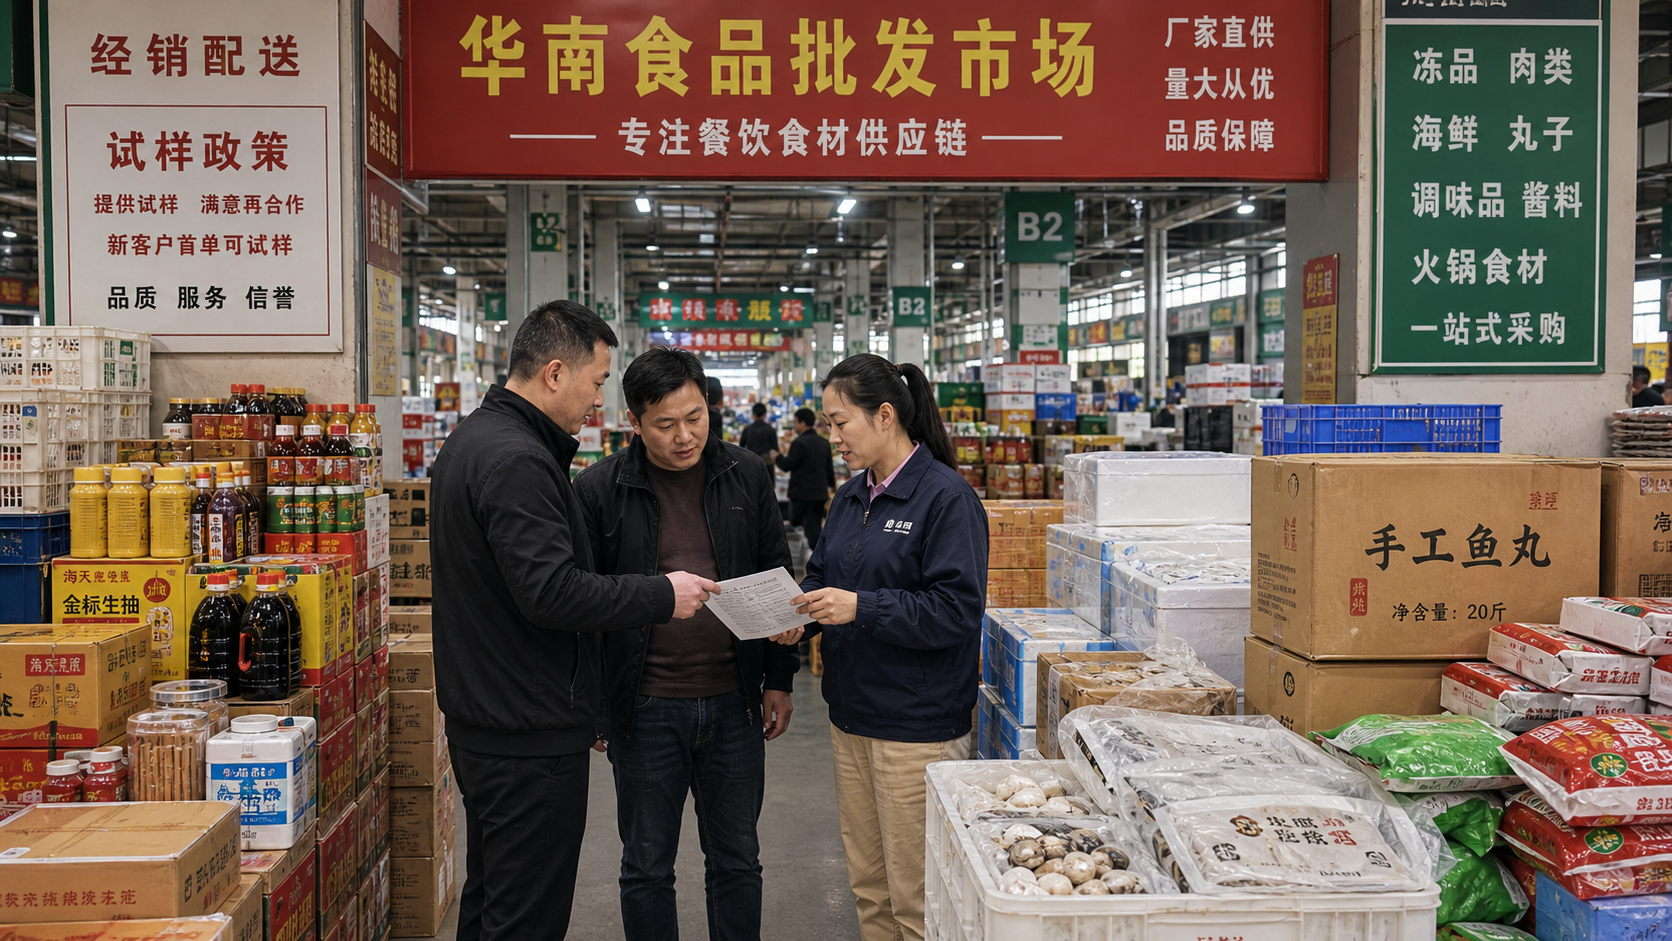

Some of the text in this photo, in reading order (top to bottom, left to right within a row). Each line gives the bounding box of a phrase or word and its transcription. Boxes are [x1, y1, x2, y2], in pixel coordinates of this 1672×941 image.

[1165, 15, 1274, 48] 厂家直供
[91, 33, 300, 77] 经销配送
[460, 15, 1094, 98] 华南食品批发市场
[1413, 48, 1572, 84] 冻品 肉类
[1165, 67, 1274, 99] 量大从优
[619, 117, 966, 156] 专注餐饮食材供应链
[1166, 119, 1274, 151] 品质保障
[1413, 115, 1573, 152] 海鲜 丸子
[107, 131, 288, 171] 试样政策
[94, 194, 303, 214] 提供试样 满意再合作
[1412, 181, 1582, 218] 调味品 酱料
[1019, 212, 1062, 241] B2
[108, 234, 292, 255] 新客户首单可试样
[1412, 248, 1547, 284] 火锅食材
[108, 286, 294, 309] 品质 服务 信誉
[898, 297, 926, 316] B2
[1411, 312, 1565, 345] 一站式采购
[1365, 524, 1551, 571] 手工鱼丸
[63, 594, 139, 615] 金标生抽
